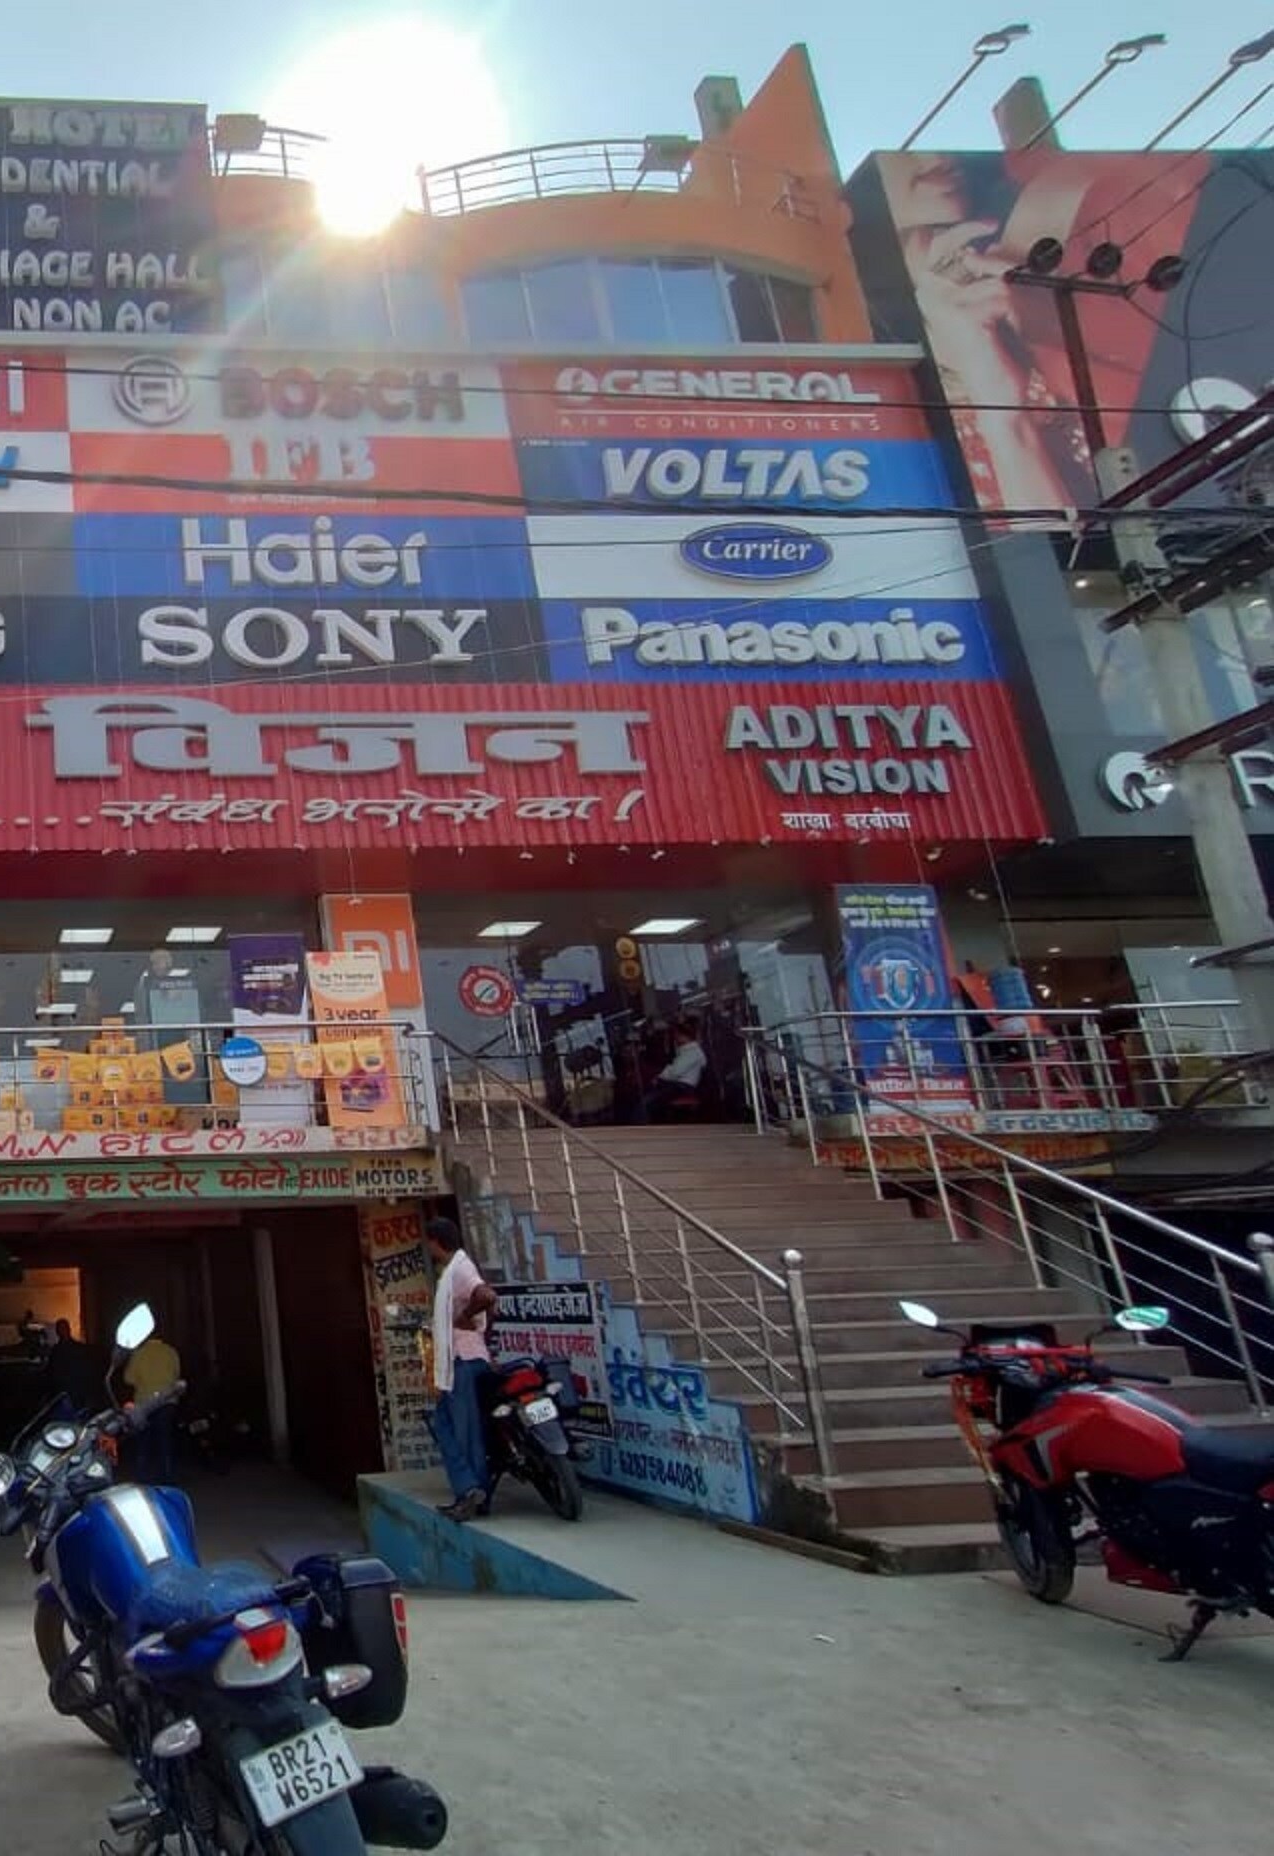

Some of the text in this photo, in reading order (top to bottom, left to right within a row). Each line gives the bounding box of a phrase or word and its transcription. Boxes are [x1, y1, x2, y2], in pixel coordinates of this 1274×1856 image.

[24, 204, 60, 239] &
[106, 252, 213, 288] HALL
[13, 298, 102, 331] NON
[115, 301, 172, 332] AC
[219, 366, 465, 422] BOSCH
[560, 416, 881, 432] AIR CONDITIONERS
[225, 433, 377, 482] IFB
[602, 448, 870, 498] VOLTAS
[181, 515, 427, 588] Haier
[702, 536, 813, 563] Carrier
[138, 605, 488, 667] SONY
[582, 607, 966, 666] Panasonic
[24, 694, 650, 779] विजन
[726, 705, 972, 750] ADITYA
[765, 759, 951, 794] VISION
[62, 1170, 121, 1200] बुक
[128, 1158, 205, 1199] स्टोर
[217, 1159, 287, 1191] फोटो
[299, 1167, 350, 1188] EXIDE
[356, 1169, 434, 1186] MOTORS
[268, 1733, 327, 1780] BR21
